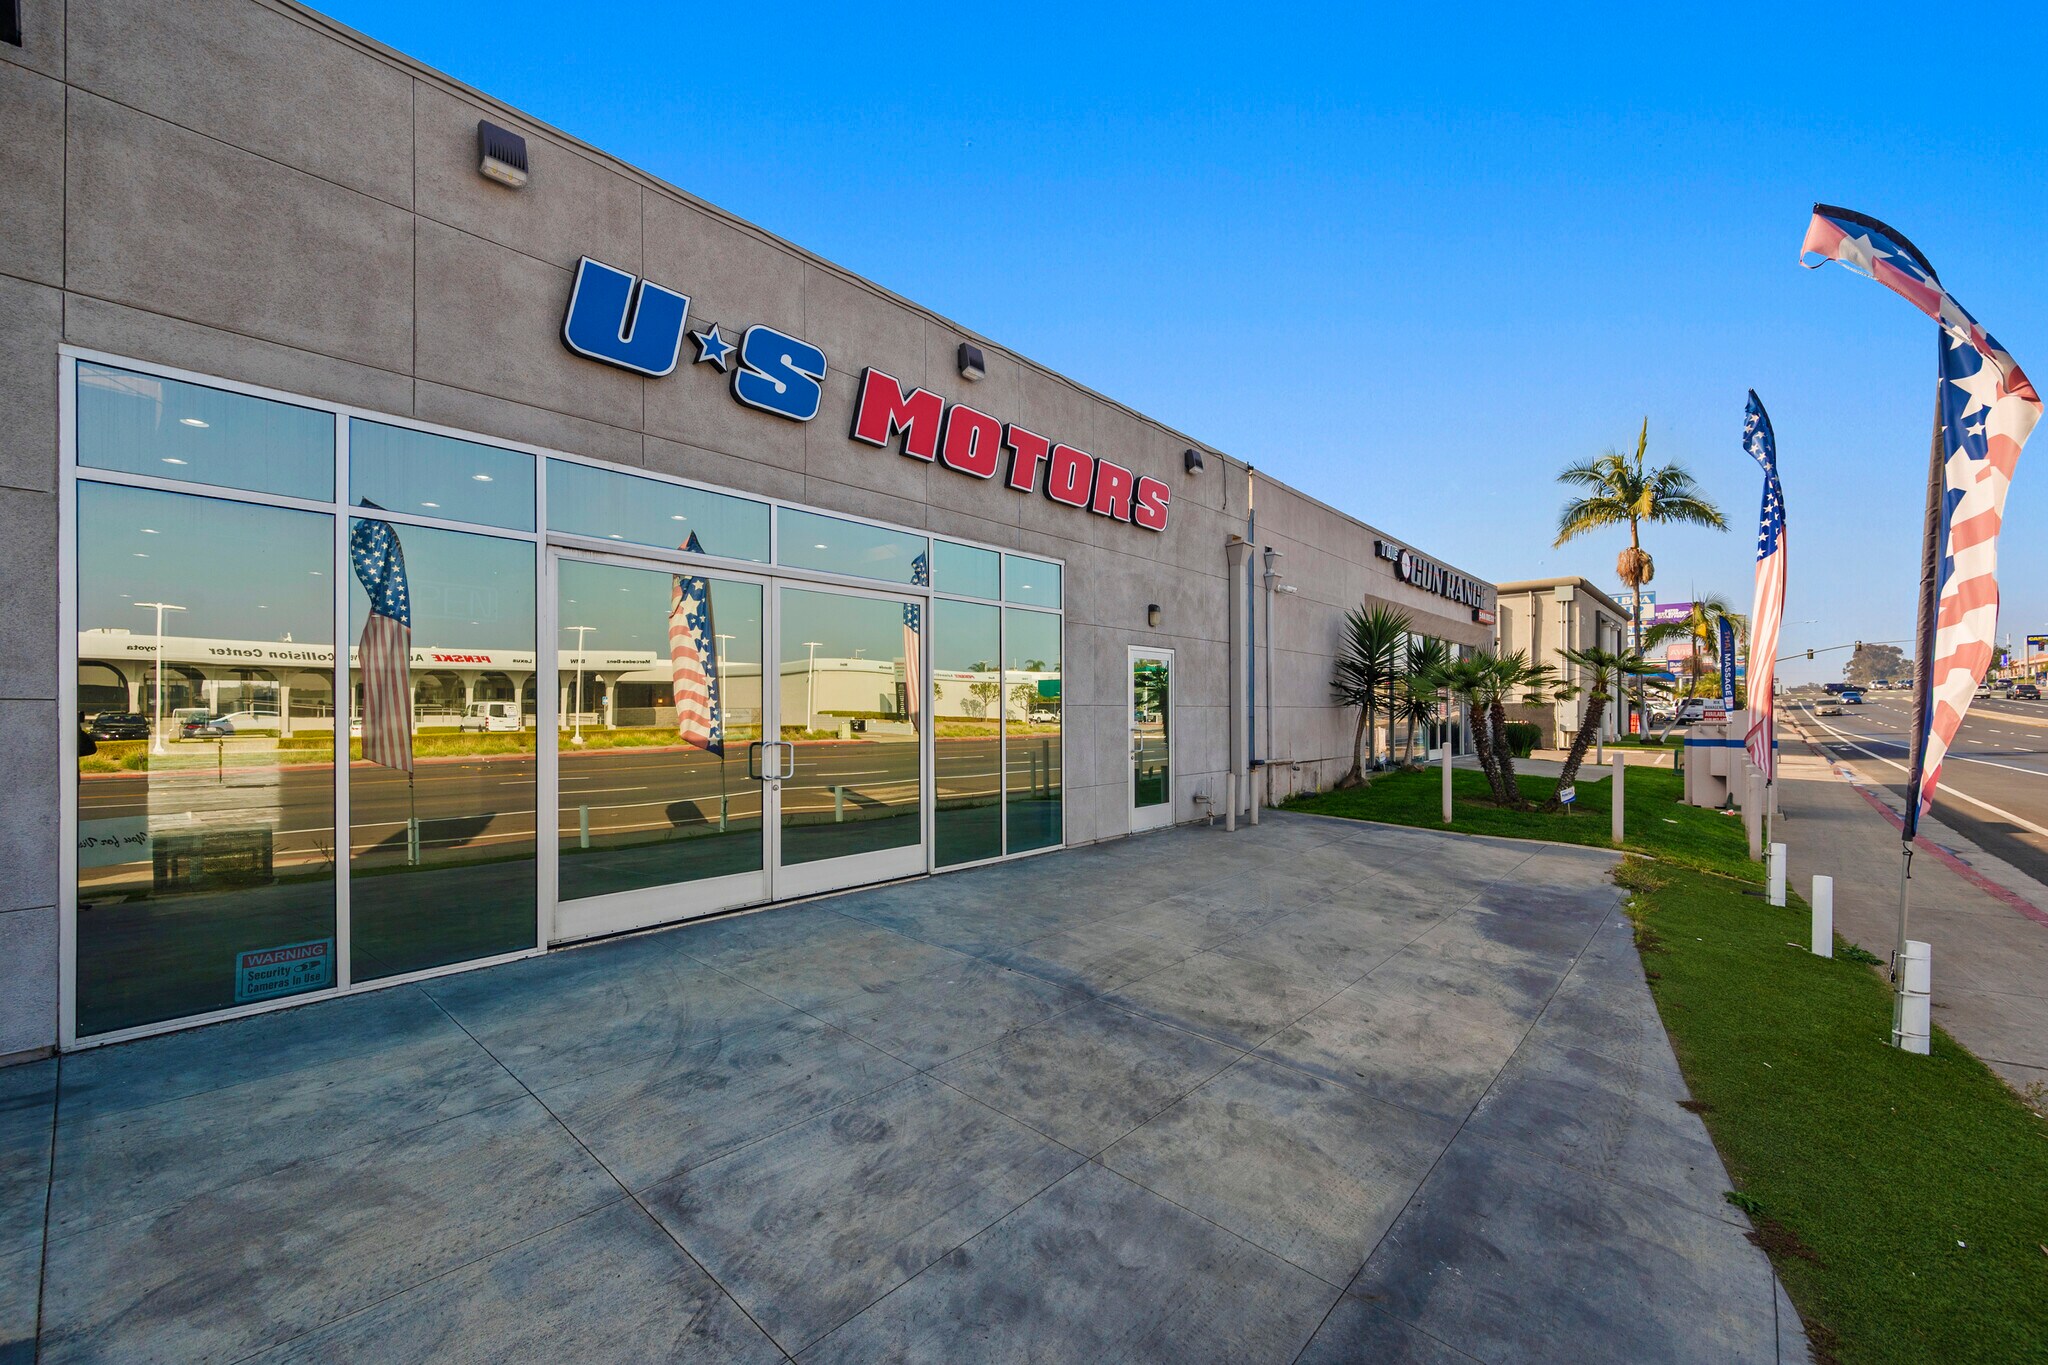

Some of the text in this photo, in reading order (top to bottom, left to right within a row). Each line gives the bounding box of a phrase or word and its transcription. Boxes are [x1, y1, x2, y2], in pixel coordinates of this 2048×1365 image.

[849, 365, 1171, 533] MOTORS
[1376, 540, 1487, 611] THE GUN RANGE
[1724, 653, 1733, 696] MASSAGE
[247, 944, 324, 967] WARNING
[247, 967, 291, 981] Security
[247, 973, 321, 994] Cameras In Use
